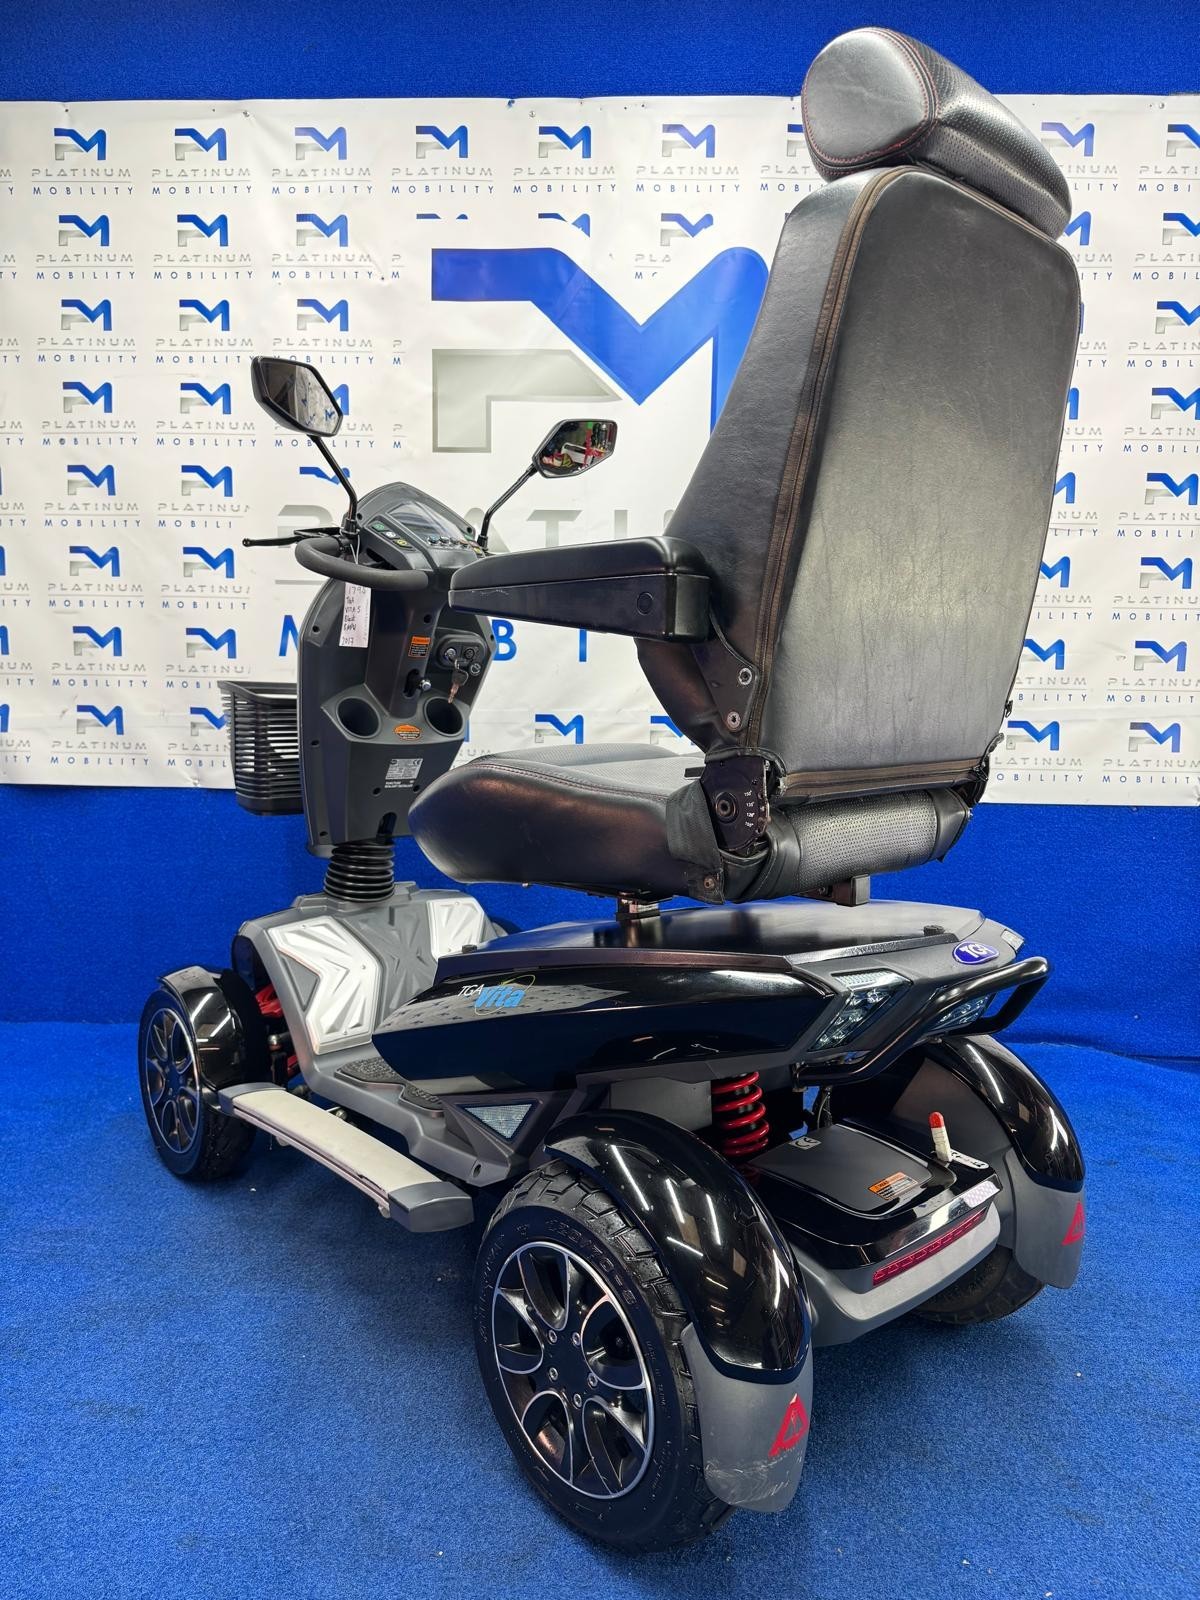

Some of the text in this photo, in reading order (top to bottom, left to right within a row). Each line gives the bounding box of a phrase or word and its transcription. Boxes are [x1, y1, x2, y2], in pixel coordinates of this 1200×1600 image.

[32, 168, 131, 177] PLATINUM
[152, 168, 250, 177] PLATINUM
[272, 168, 371, 177] PLATINUM
[392, 166, 492, 176] PLATINUM
[513, 166, 615, 176] PLATINUM
[636, 166, 739, 175] PLATINUM
[761, 165, 810, 174] PLAT
[1139, 165, 1198, 174] PLATI
[33, 187, 132, 195] MOBILITY
[152, 186, 251, 194] MOBILITY
[272, 186, 372, 194] MOBILITY
[392, 185, 493, 193] MOBILITY
[513, 184, 615, 193] MOBILITY
[636, 184, 739, 192] MOBILITY
[760, 184, 811, 192] MOBI
[1075, 183, 1118, 191] LITY
[1139, 184, 1190, 192] MOBI
[36, 253, 133, 262] PLATINUM
[154, 254, 251, 264] PLATINUM
[272, 254, 372, 264] PLATINUM
[1135, 253, 1200, 262] PLATI
[154, 271, 252, 279] MOBILITY
[272, 271, 372, 279] MOBILITY
[1133, 272, 1199, 280] MOBIL
[155, 338, 253, 347] PLATINUM
[273, 338, 372, 347] PLATINUM
[1128, 342, 1200, 350] PLATIN
[40, 420, 136, 429] PLATINUM
[156, 421, 255, 430] PLATINUM
[1124, 426, 1198, 436] PLATIN
[157, 438, 256, 446] MOBILITY
[275, 440, 374, 448] MOBLITY
[1124, 445, 1198, 453] MOBILI
[44, 502, 139, 511] PLATINUM
[159, 520, 231, 528] MOBILI
[48, 583, 143, 592] PLATINUM
[1113, 596, 1200, 604] PLATINU
[163, 601, 246, 609] MOBILIT
[51, 662, 146, 672] PLATINUM
[166, 664, 250, 673] PLATINU
[52, 741, 147, 750] PLATINUM
[168, 743, 230, 752] PLATIN
[51, 757, 148, 765] MOBILITY
[168, 759, 226, 767] MOBIL
[995, 757, 1082, 767] LATINUM
[457, 983, 526, 1008] TGA Vita
